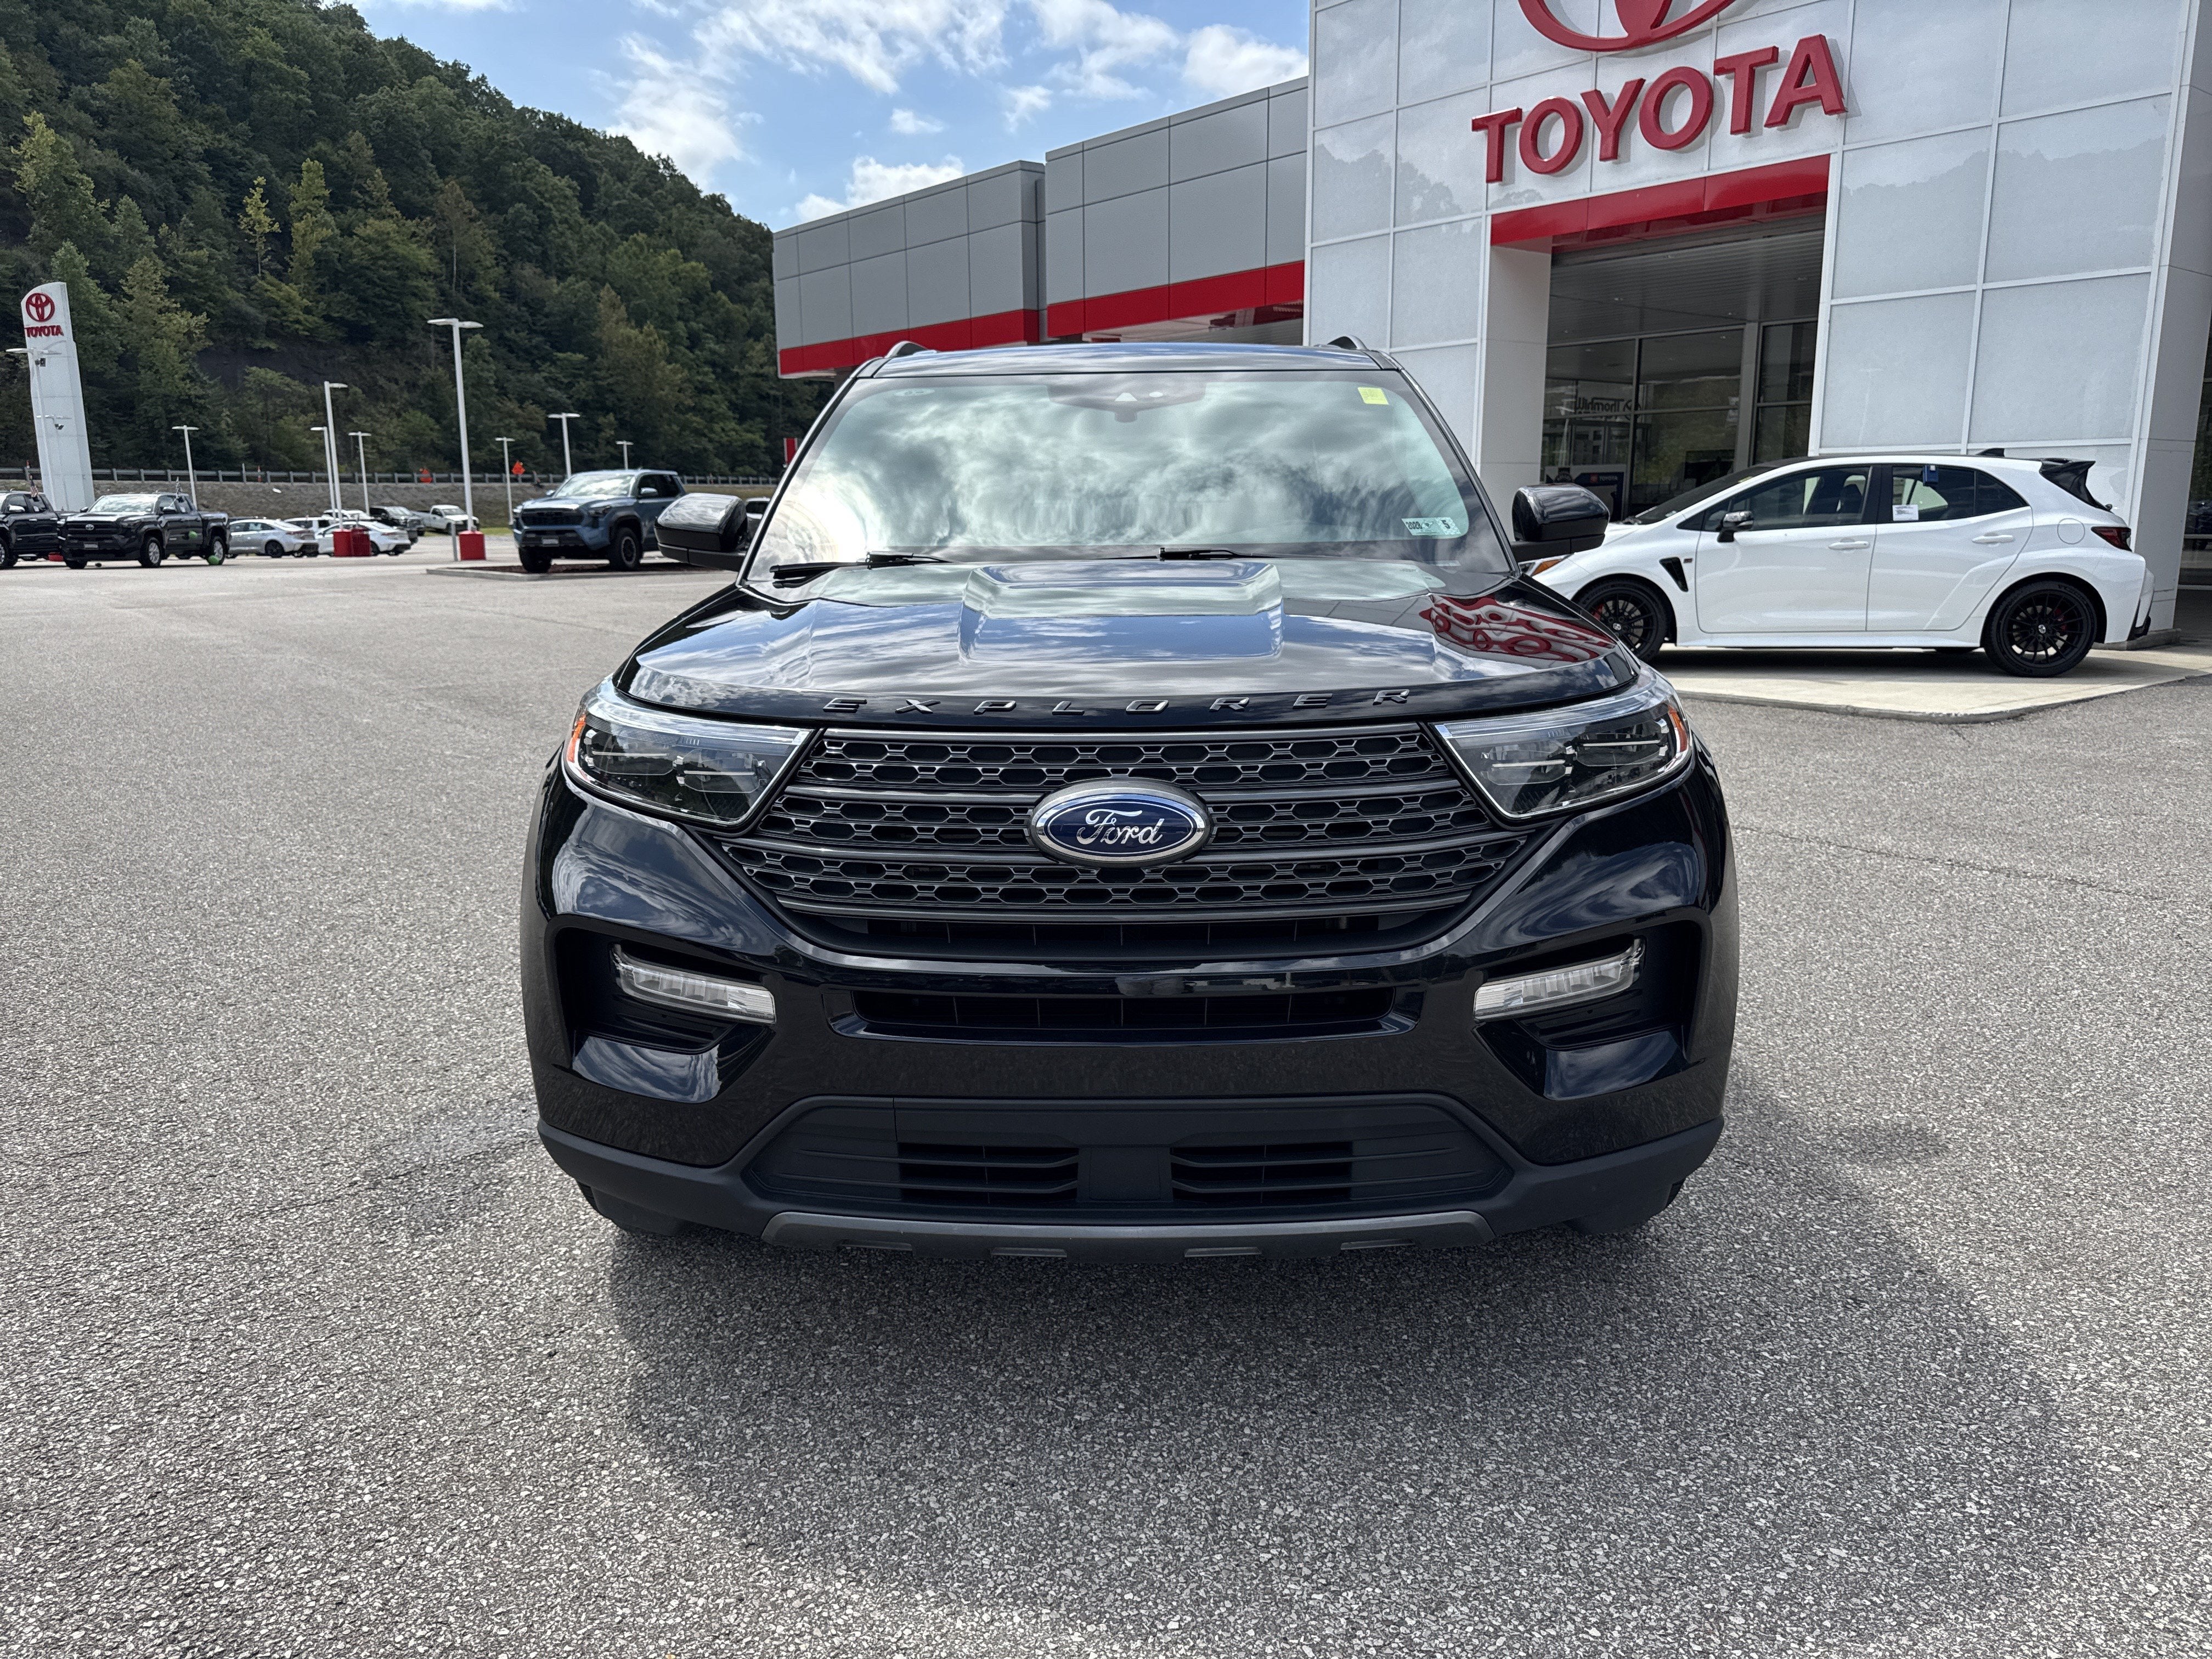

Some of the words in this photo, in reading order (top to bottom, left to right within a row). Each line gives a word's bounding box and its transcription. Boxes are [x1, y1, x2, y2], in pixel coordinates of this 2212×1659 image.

[1472, 34, 1847, 183] TOYOTA
[24, 325, 64, 338] TOYOTA
[1441, 520, 1451, 529] 5
[822, 688, 1411, 714] EXPLORER
[1076, 808, 1165, 845] Ford
